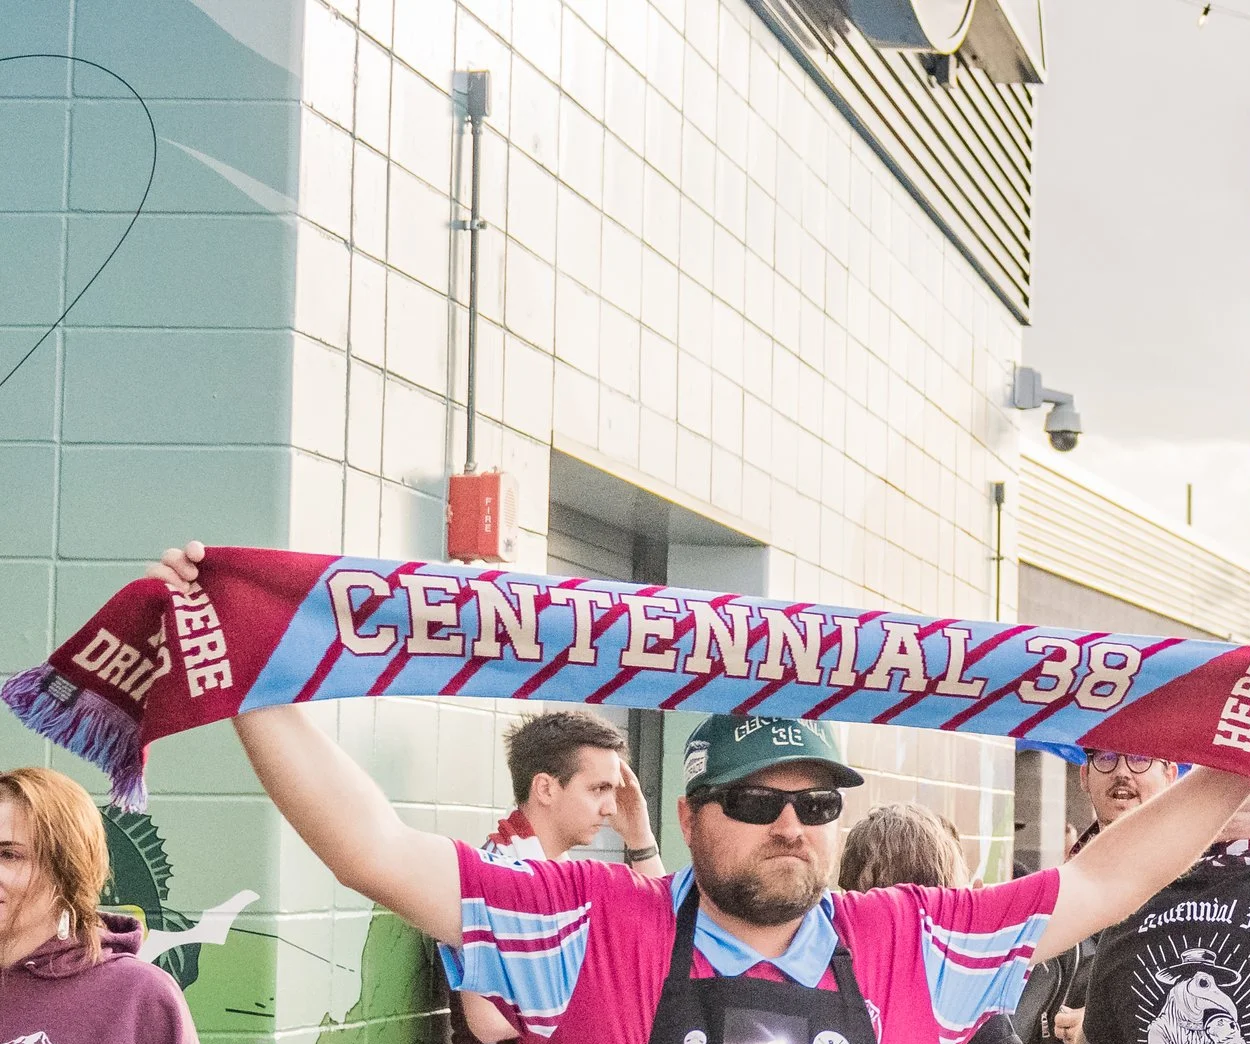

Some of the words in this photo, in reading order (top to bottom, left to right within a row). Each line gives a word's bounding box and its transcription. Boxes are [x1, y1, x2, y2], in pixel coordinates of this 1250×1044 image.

[484, 497, 492, 533] FIRE
[72, 627, 155, 701] DRI
[326, 570, 988, 699] CENTENNIAL
[1015, 635, 1142, 712] 38
